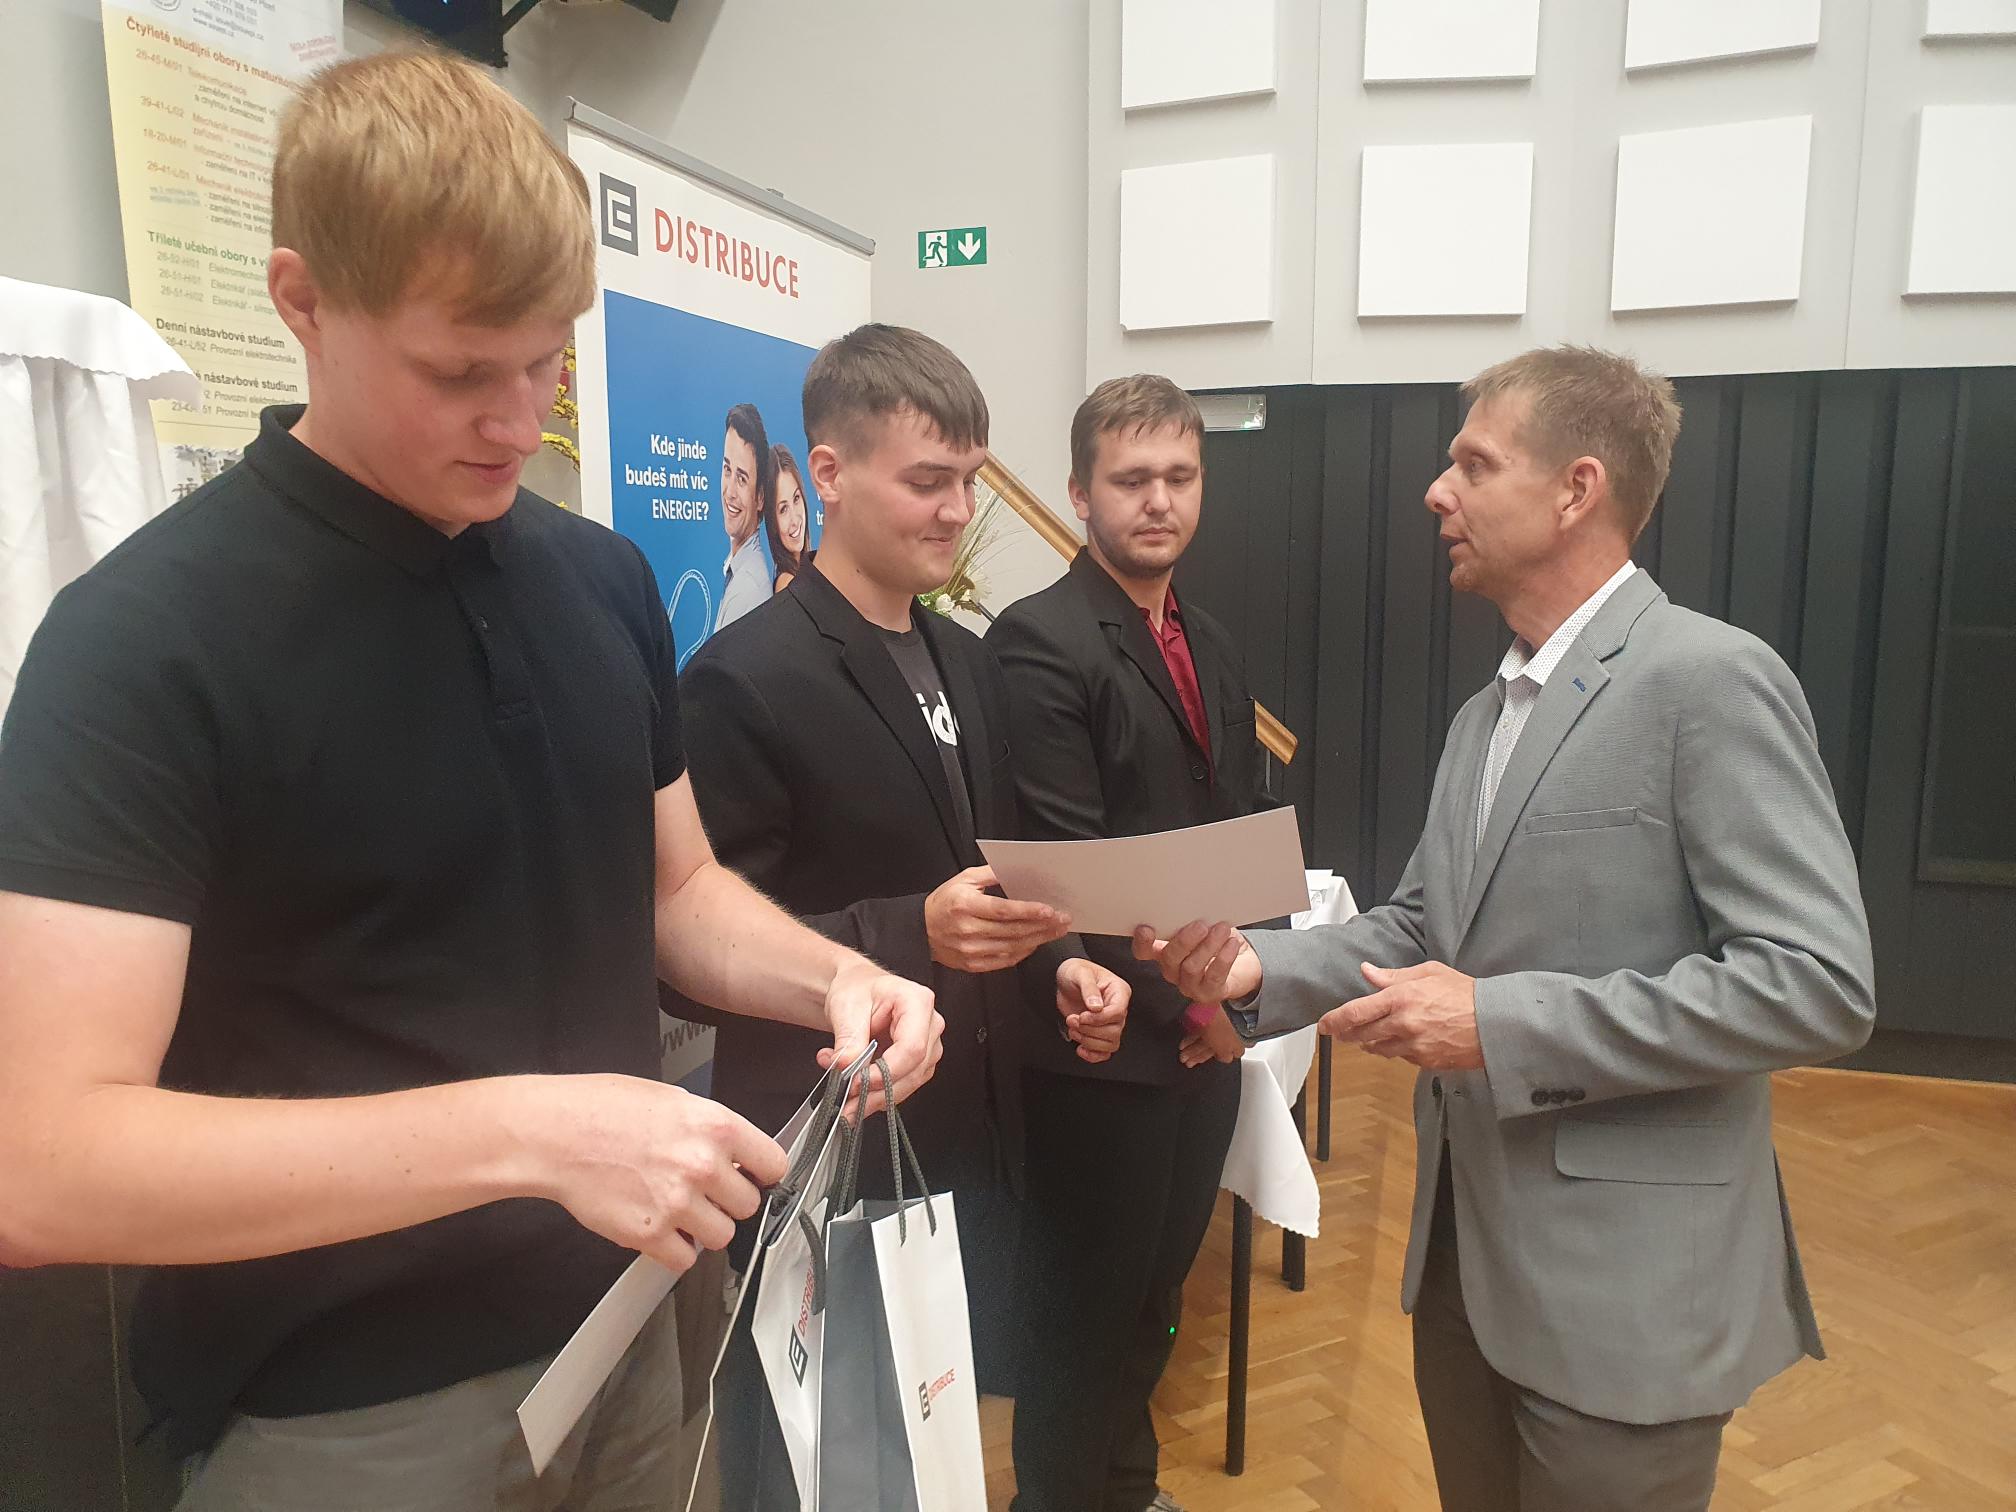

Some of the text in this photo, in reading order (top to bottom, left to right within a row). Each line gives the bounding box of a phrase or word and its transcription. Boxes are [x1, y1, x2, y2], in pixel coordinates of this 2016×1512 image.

[213, 51, 241, 71] obory
[220, 249, 249, 266] obory
[654, 207, 799, 299] DISTRIBUCE
[156, 317, 285, 349] Denní nástavbové studium
[204, 370, 259, 388] nástavbové
[261, 379, 298, 393] studium
[650, 433, 707, 462] Kde jinde
[625, 463, 709, 491] budeš mít víc
[652, 498, 710, 521] ENERGIE?
